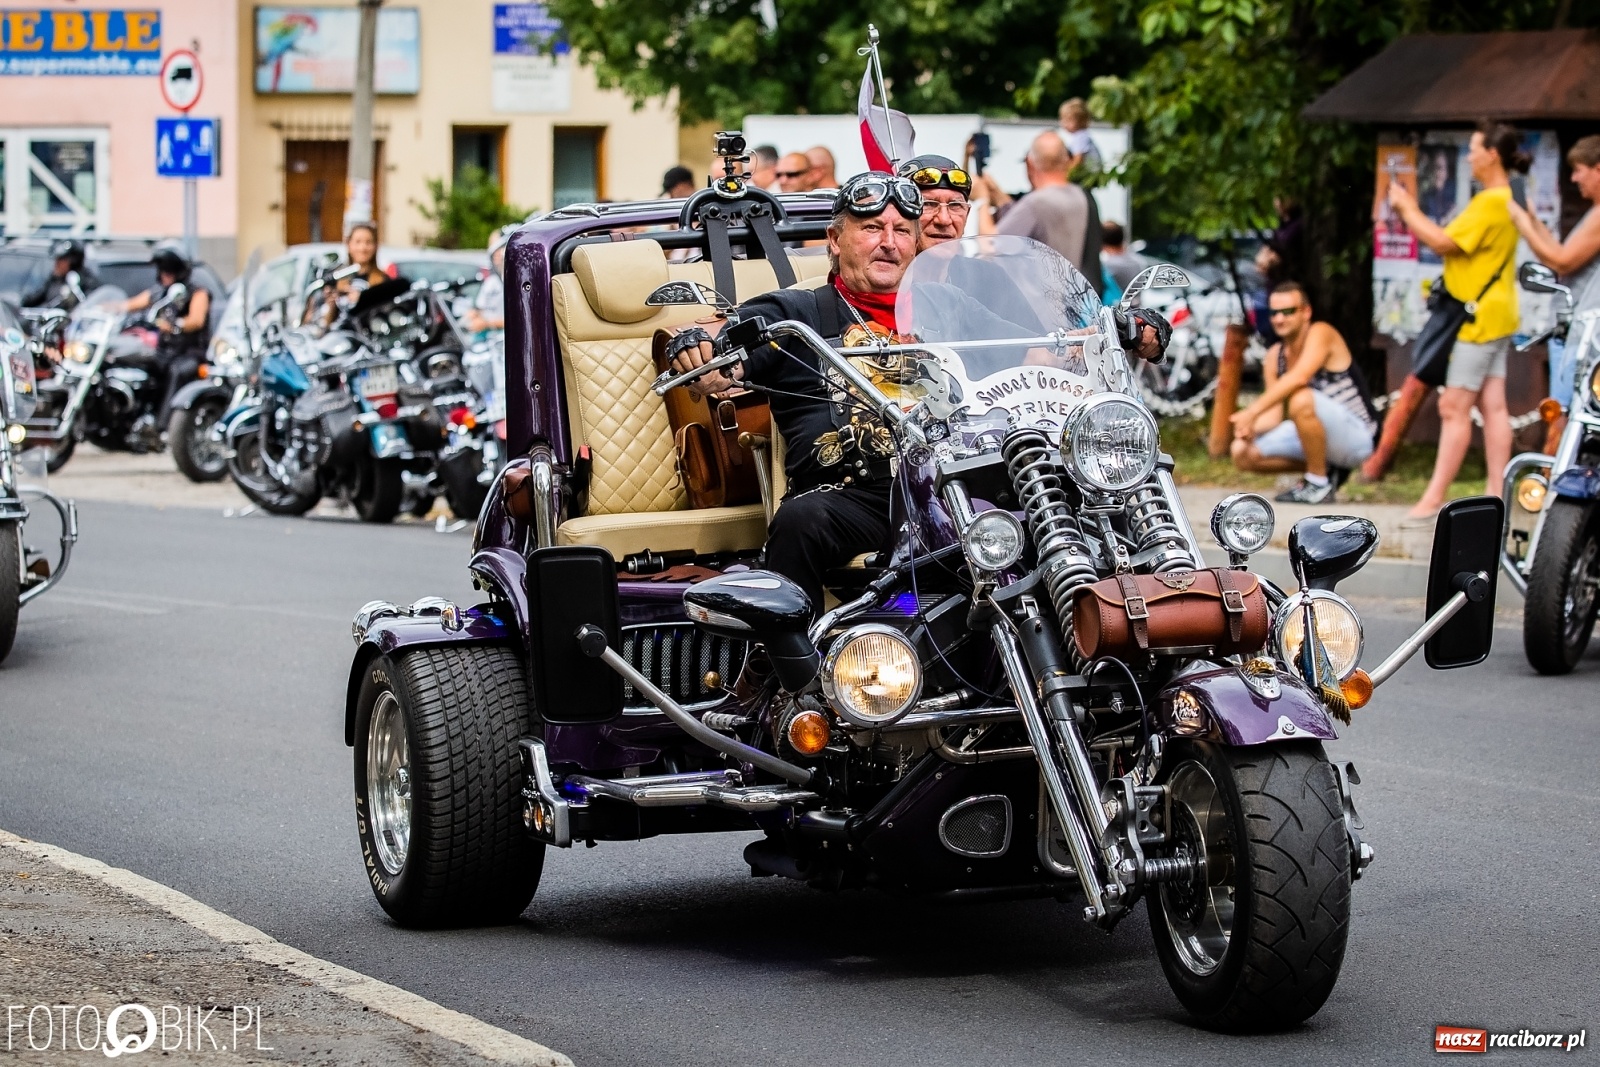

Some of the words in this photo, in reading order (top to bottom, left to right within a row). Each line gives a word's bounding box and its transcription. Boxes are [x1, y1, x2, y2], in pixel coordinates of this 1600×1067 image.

[0, 11, 160, 52] EBLE
[976, 372, 1031, 406] Sweet
[1010, 400, 1069, 417] TRIKE
[363, 841, 390, 896] RADIAL
